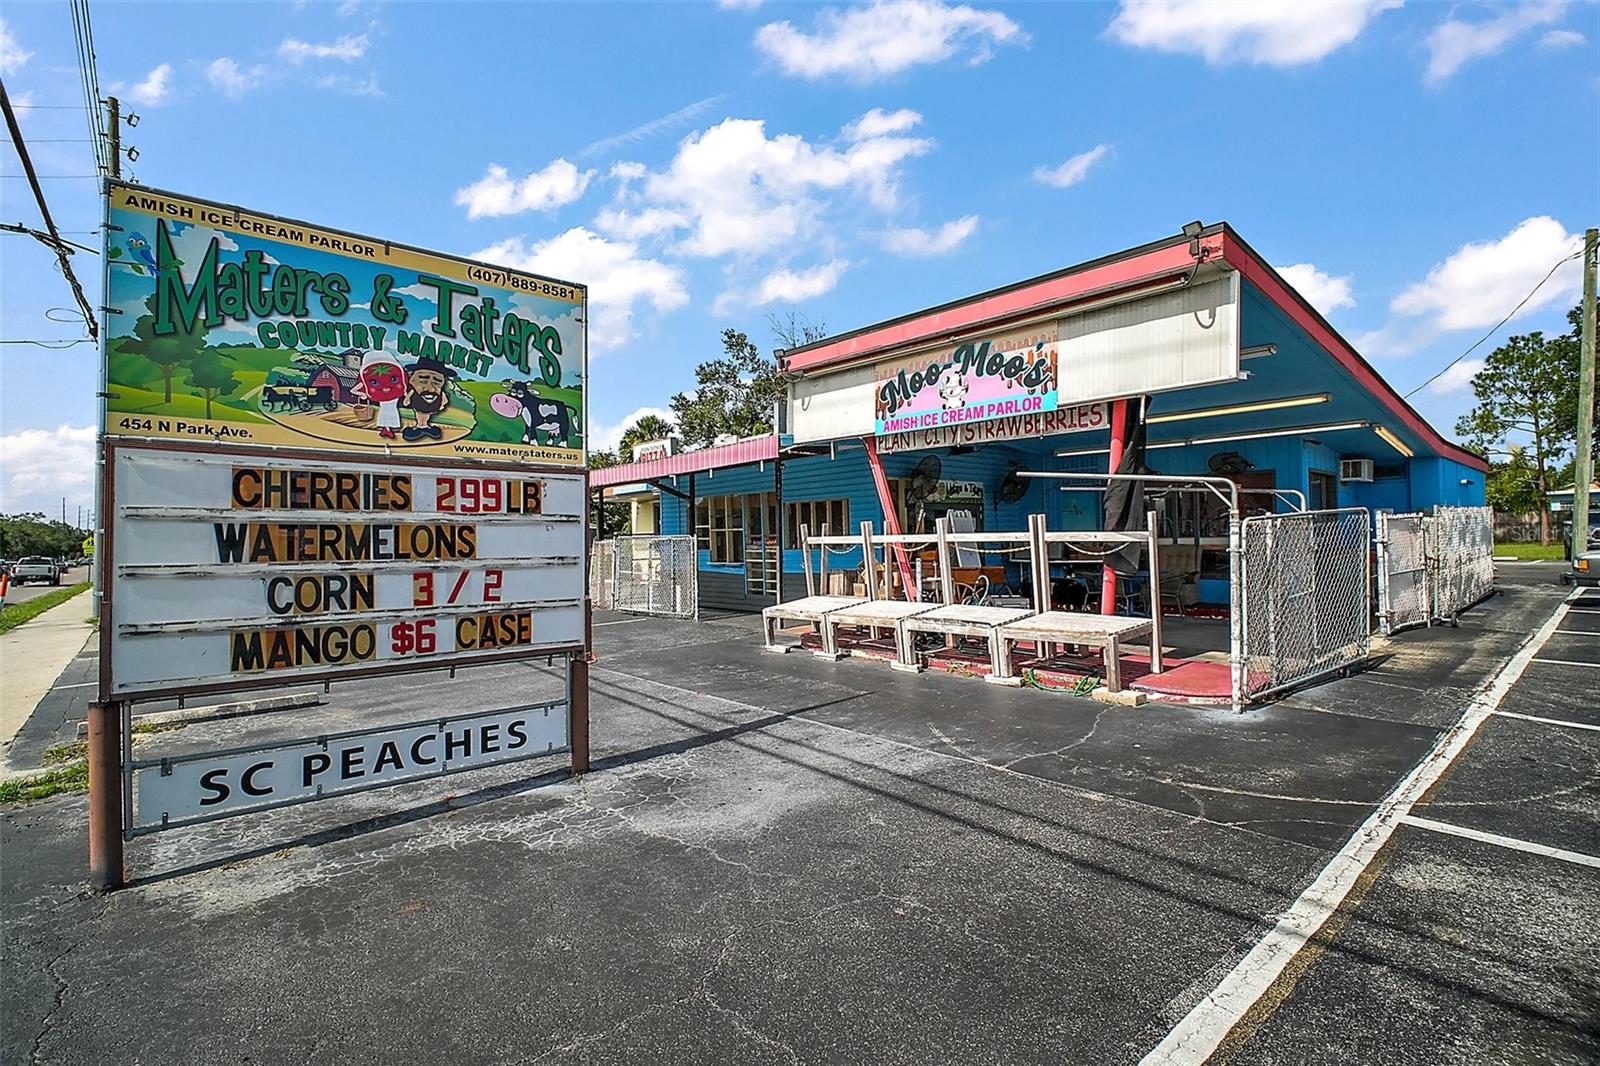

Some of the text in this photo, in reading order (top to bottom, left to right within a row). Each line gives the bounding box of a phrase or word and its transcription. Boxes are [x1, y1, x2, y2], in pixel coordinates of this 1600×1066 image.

[125, 195, 375, 257] AMISH ICE CREAM PARLOR
[152, 217, 562, 388] Maters & Taters
[467, 266, 576, 300] (407) 889-8581
[257, 321, 494, 378] COUNTRY MARKET
[119, 418, 253, 438] 454 N Park Ave.
[878, 403, 1103, 451] PLANT CITY STRAWBERRIES
[883, 396, 1042, 433] AMISH ICE CREAM PARLOR
[454, 444, 579, 461] www.materstaters.us
[232, 468, 412, 510] CHERRIES
[213, 522, 477, 563] WATERMELONS
[267, 573, 375, 615] CORN
[231, 614, 532, 672] MANGO $6 CASE
[199, 720, 527, 806] SC PEACHES
